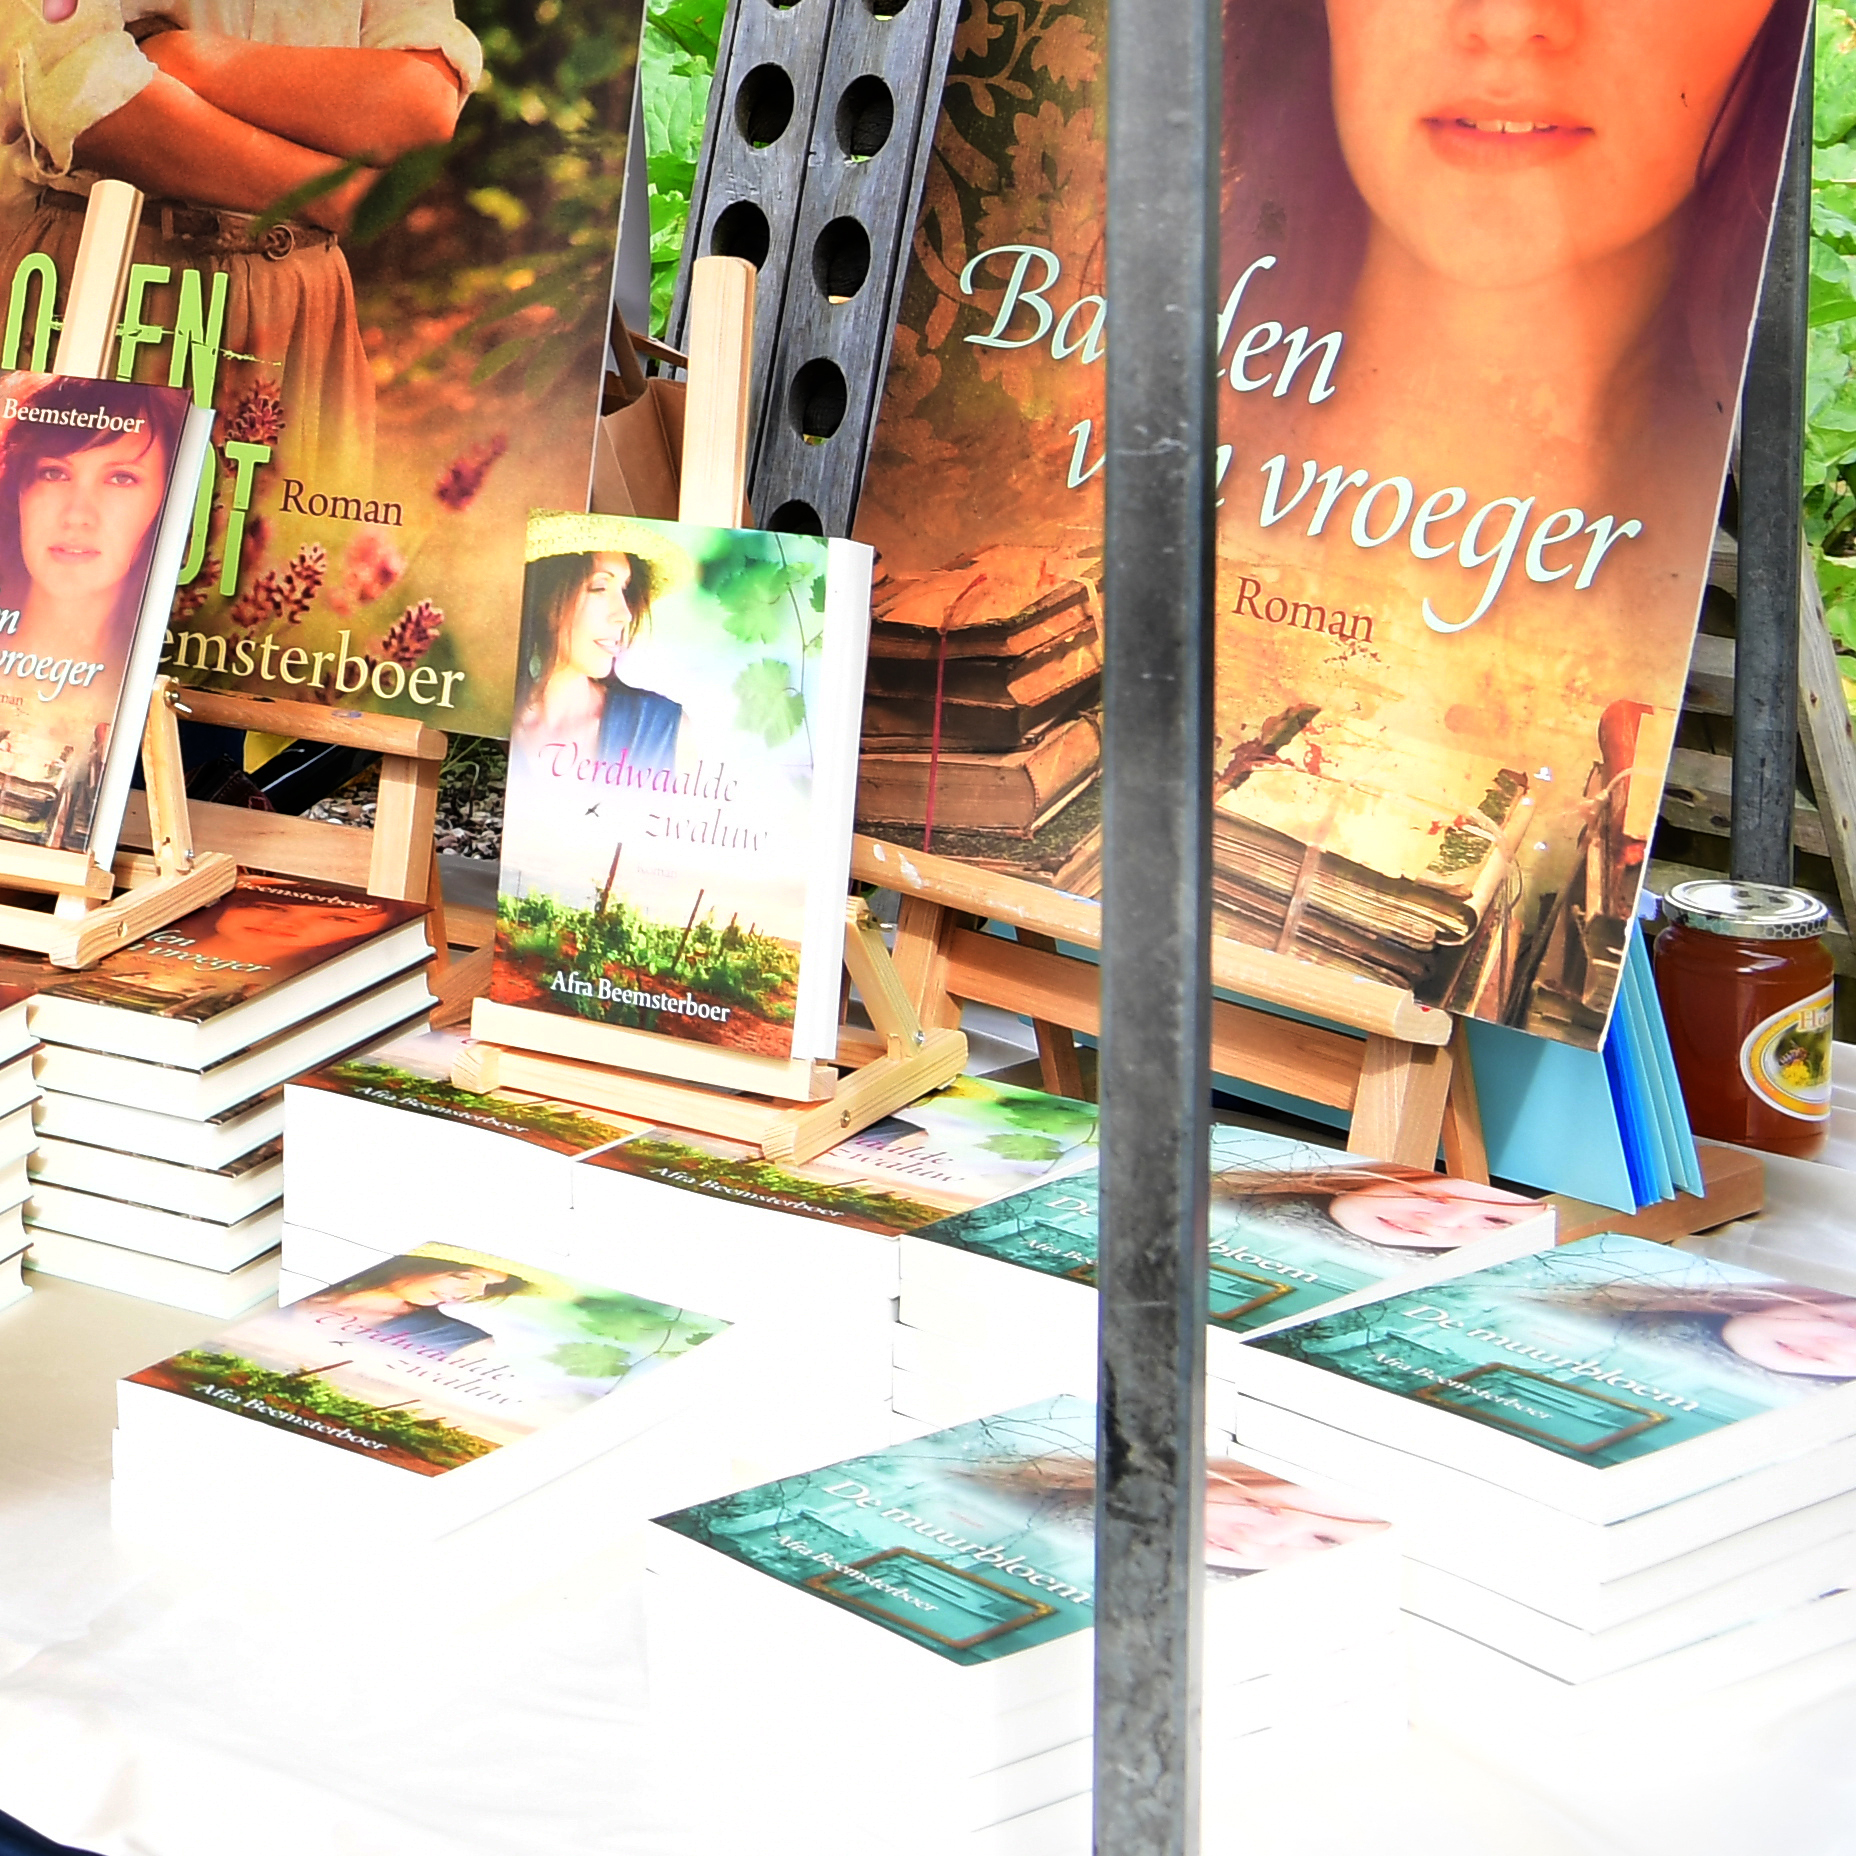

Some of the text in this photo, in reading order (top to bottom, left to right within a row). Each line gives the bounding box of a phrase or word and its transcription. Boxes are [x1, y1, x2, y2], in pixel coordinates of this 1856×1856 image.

[0, 250, 231, 411] OEN
[959, 243, 1346, 406] Baen
[2, 396, 146, 435] Beemsterboer
[279, 477, 404, 528] Roman
[1259, 452, 1643, 635] vroeger
[1232, 577, 1376, 645] Roman
[157, 628, 467, 710] emsterboer
[538, 741, 739, 804] Verdwaalde
[548, 969, 731, 1024] Afra Beemsterboer
[354, 1086, 530, 1133] Afra Beemsterboer
[649, 1166, 846, 1218] Afra Beemsterboer
[1207, 1240, 1320, 1284] bloem
[1371, 1351, 1554, 1421] Afra Beemsterboer
[1402, 1305, 1701, 1412] De muurbloem
[192, 1382, 389, 1452] Afra Beemsterboer
[773, 1533, 939, 1612] Afra Beemsterboer
[822, 1479, 1095, 1605] De muurbloem
